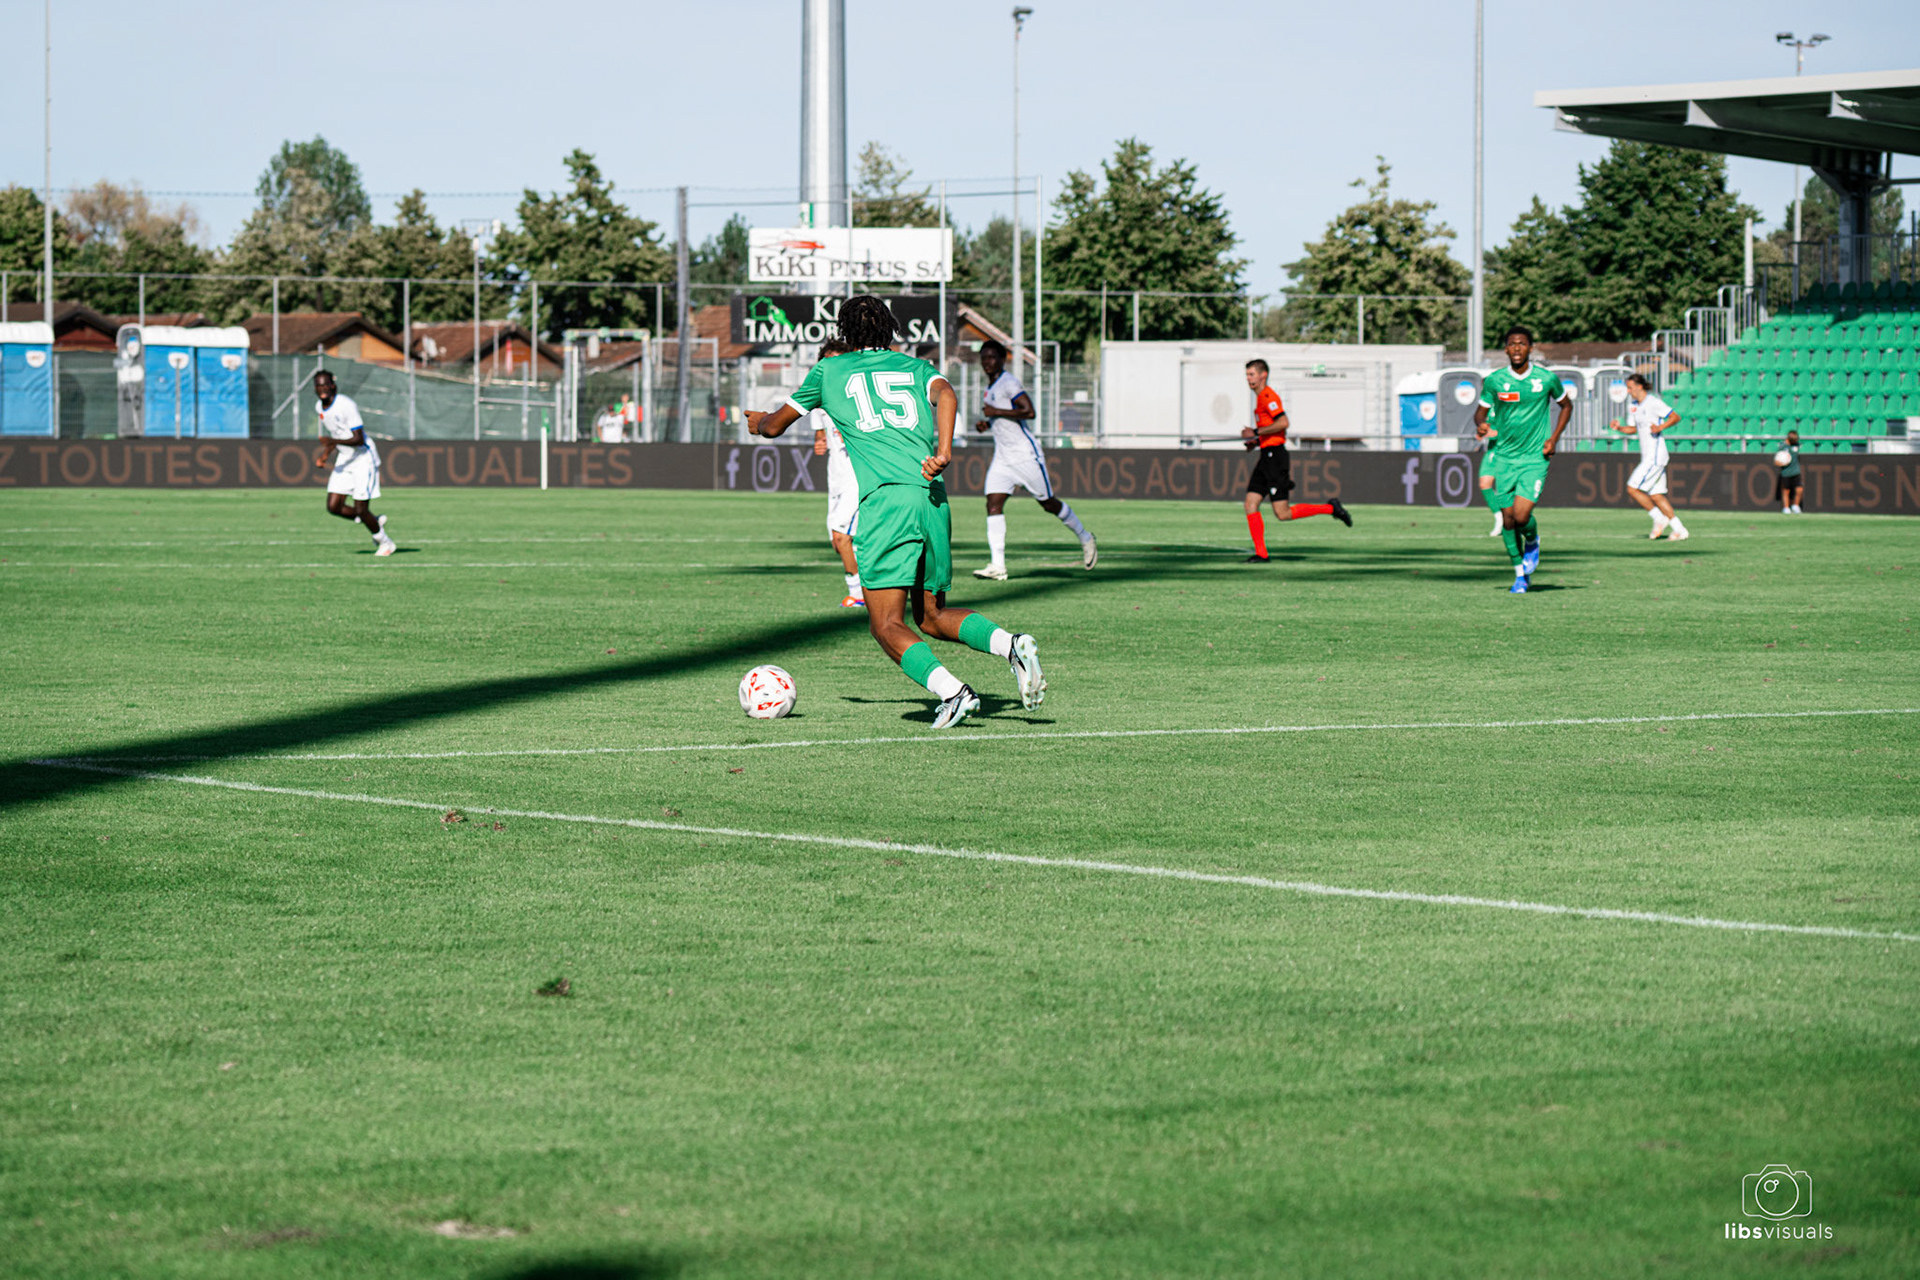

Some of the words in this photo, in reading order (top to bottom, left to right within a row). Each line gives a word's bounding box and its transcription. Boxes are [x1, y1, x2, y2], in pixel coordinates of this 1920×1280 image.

[917, 261, 947, 277] SA
[907, 318, 940, 343] SA
[845, 371, 919, 432] 15
[29, 444, 222, 485] TOUTES
[1072, 457, 1136, 495] NOS
[1576, 461, 1713, 505] SUEZ
[1724, 463, 1881, 508] TOTES
